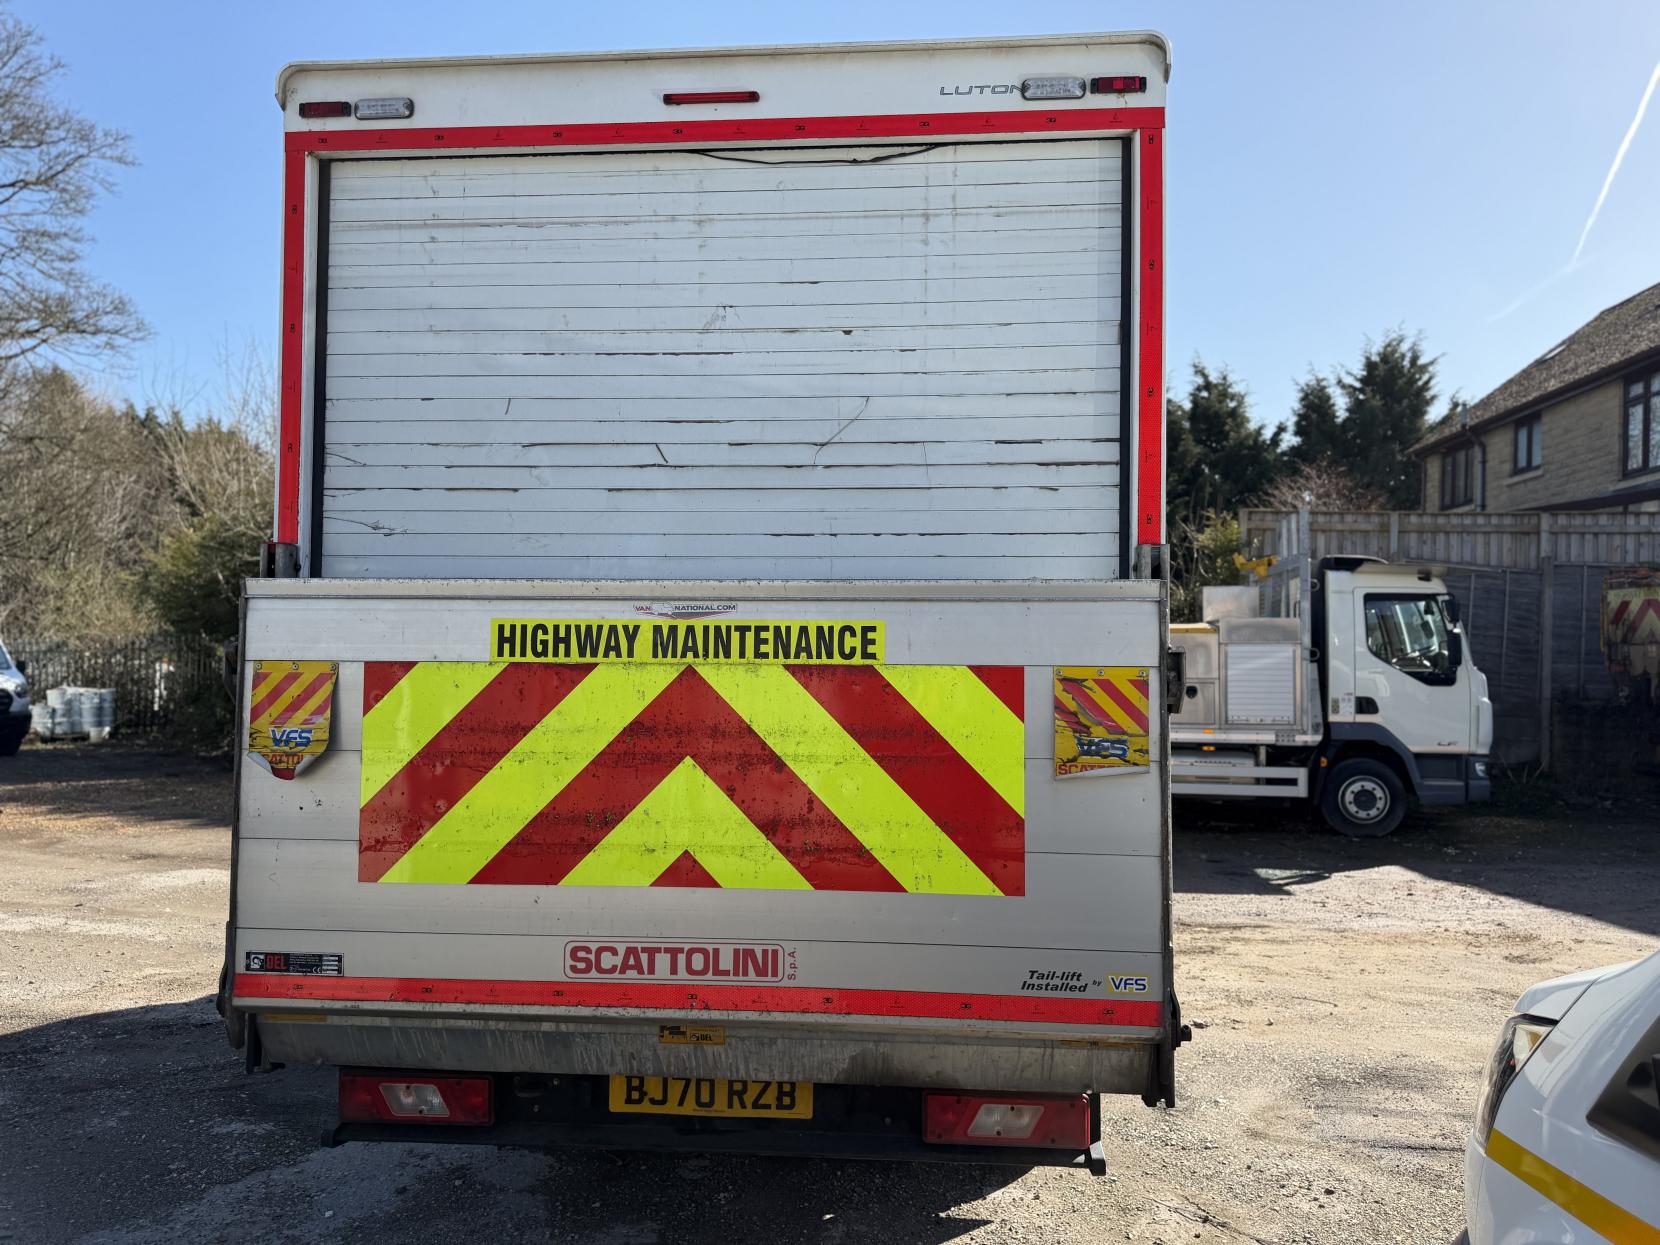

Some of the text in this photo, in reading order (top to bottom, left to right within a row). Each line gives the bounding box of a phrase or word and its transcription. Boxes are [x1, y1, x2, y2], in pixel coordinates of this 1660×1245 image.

[674, 604, 736, 612] NATIONAL.COM
[497, 623, 877, 660] HIGHWAY MAINTENANCE
[270, 729, 313, 748] VFS
[569, 945, 779, 978] SCATTOLINI
[1020, 976, 1147, 993] Installed by VFS
[1028, 970, 1083, 982] Tail-lift
[624, 1076, 796, 1111] BJ70 RZB
